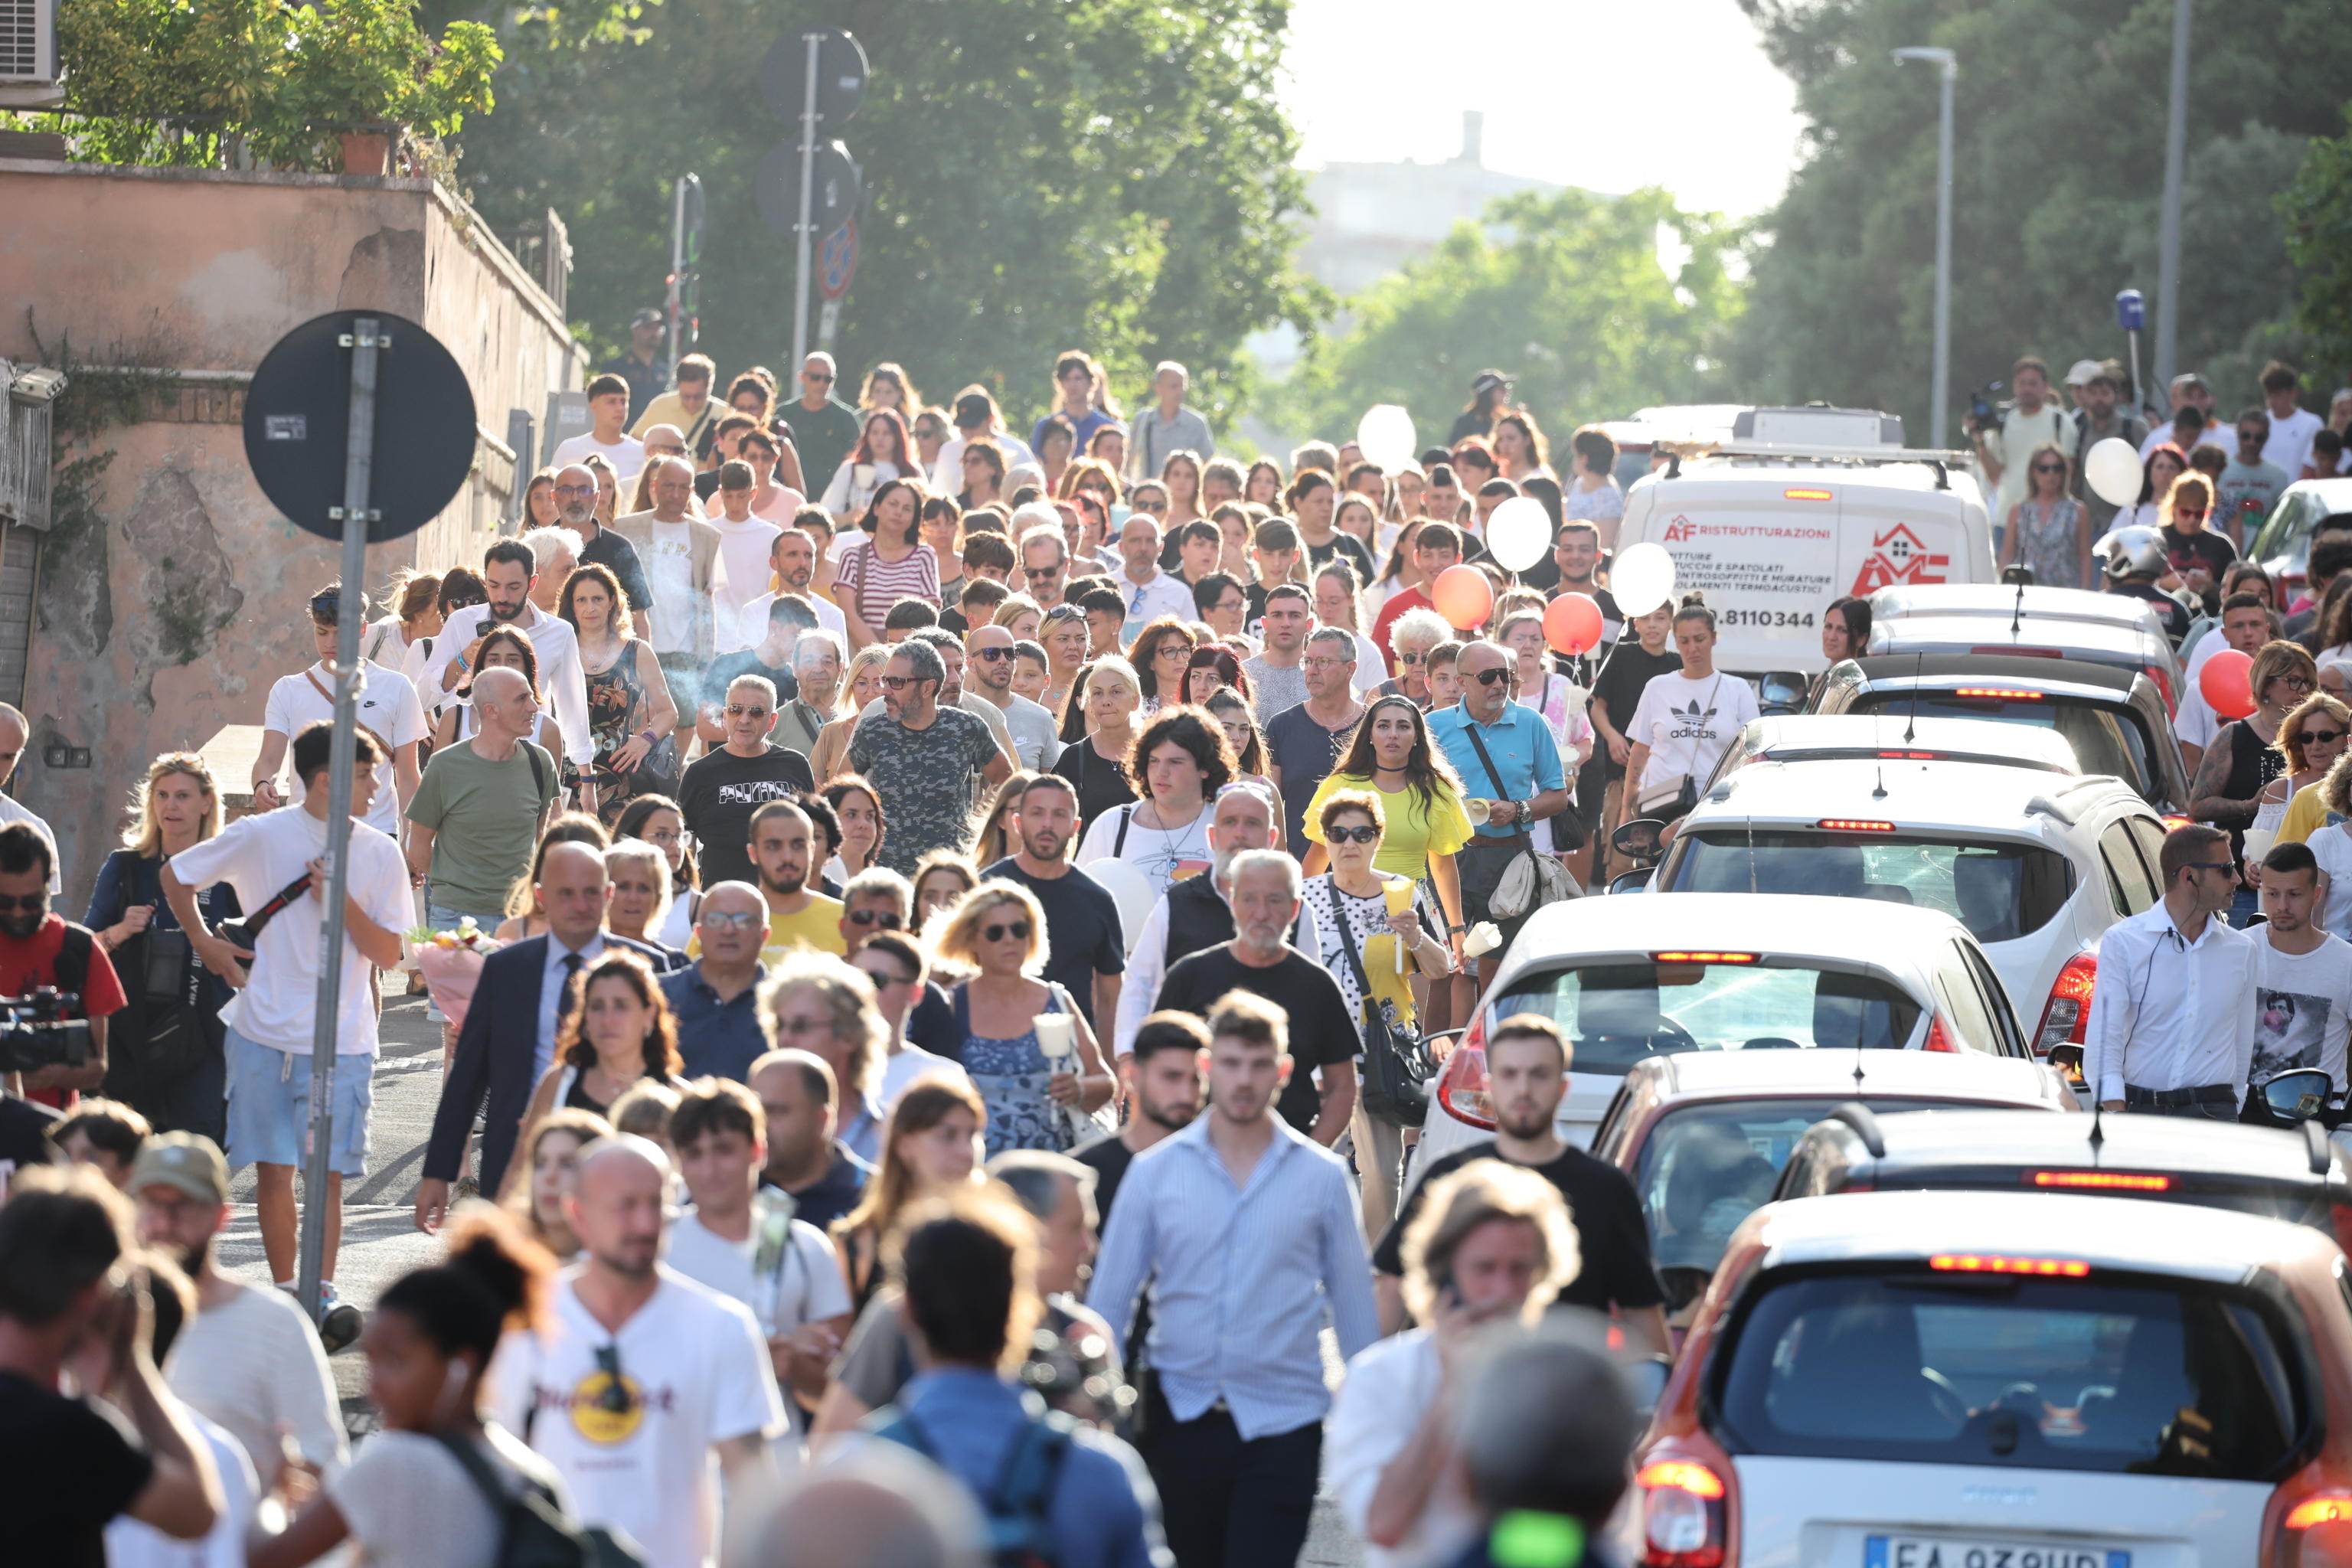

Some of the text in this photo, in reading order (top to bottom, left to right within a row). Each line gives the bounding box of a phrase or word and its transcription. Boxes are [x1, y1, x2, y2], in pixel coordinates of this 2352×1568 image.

[1664, 524, 1831, 542] AF RISTRUTTURAZIONI
[1675, 561, 1713, 570] TUCCHI
[1726, 563, 1784, 573] SPATOLATI
[1675, 571, 1831, 585] ONTROSOFFITTI E MURATURE
[1735, 583, 1823, 594] TERMOACUSTICI
[1670, 727, 1717, 740] adidas
[719, 781, 790, 804] PUMA
